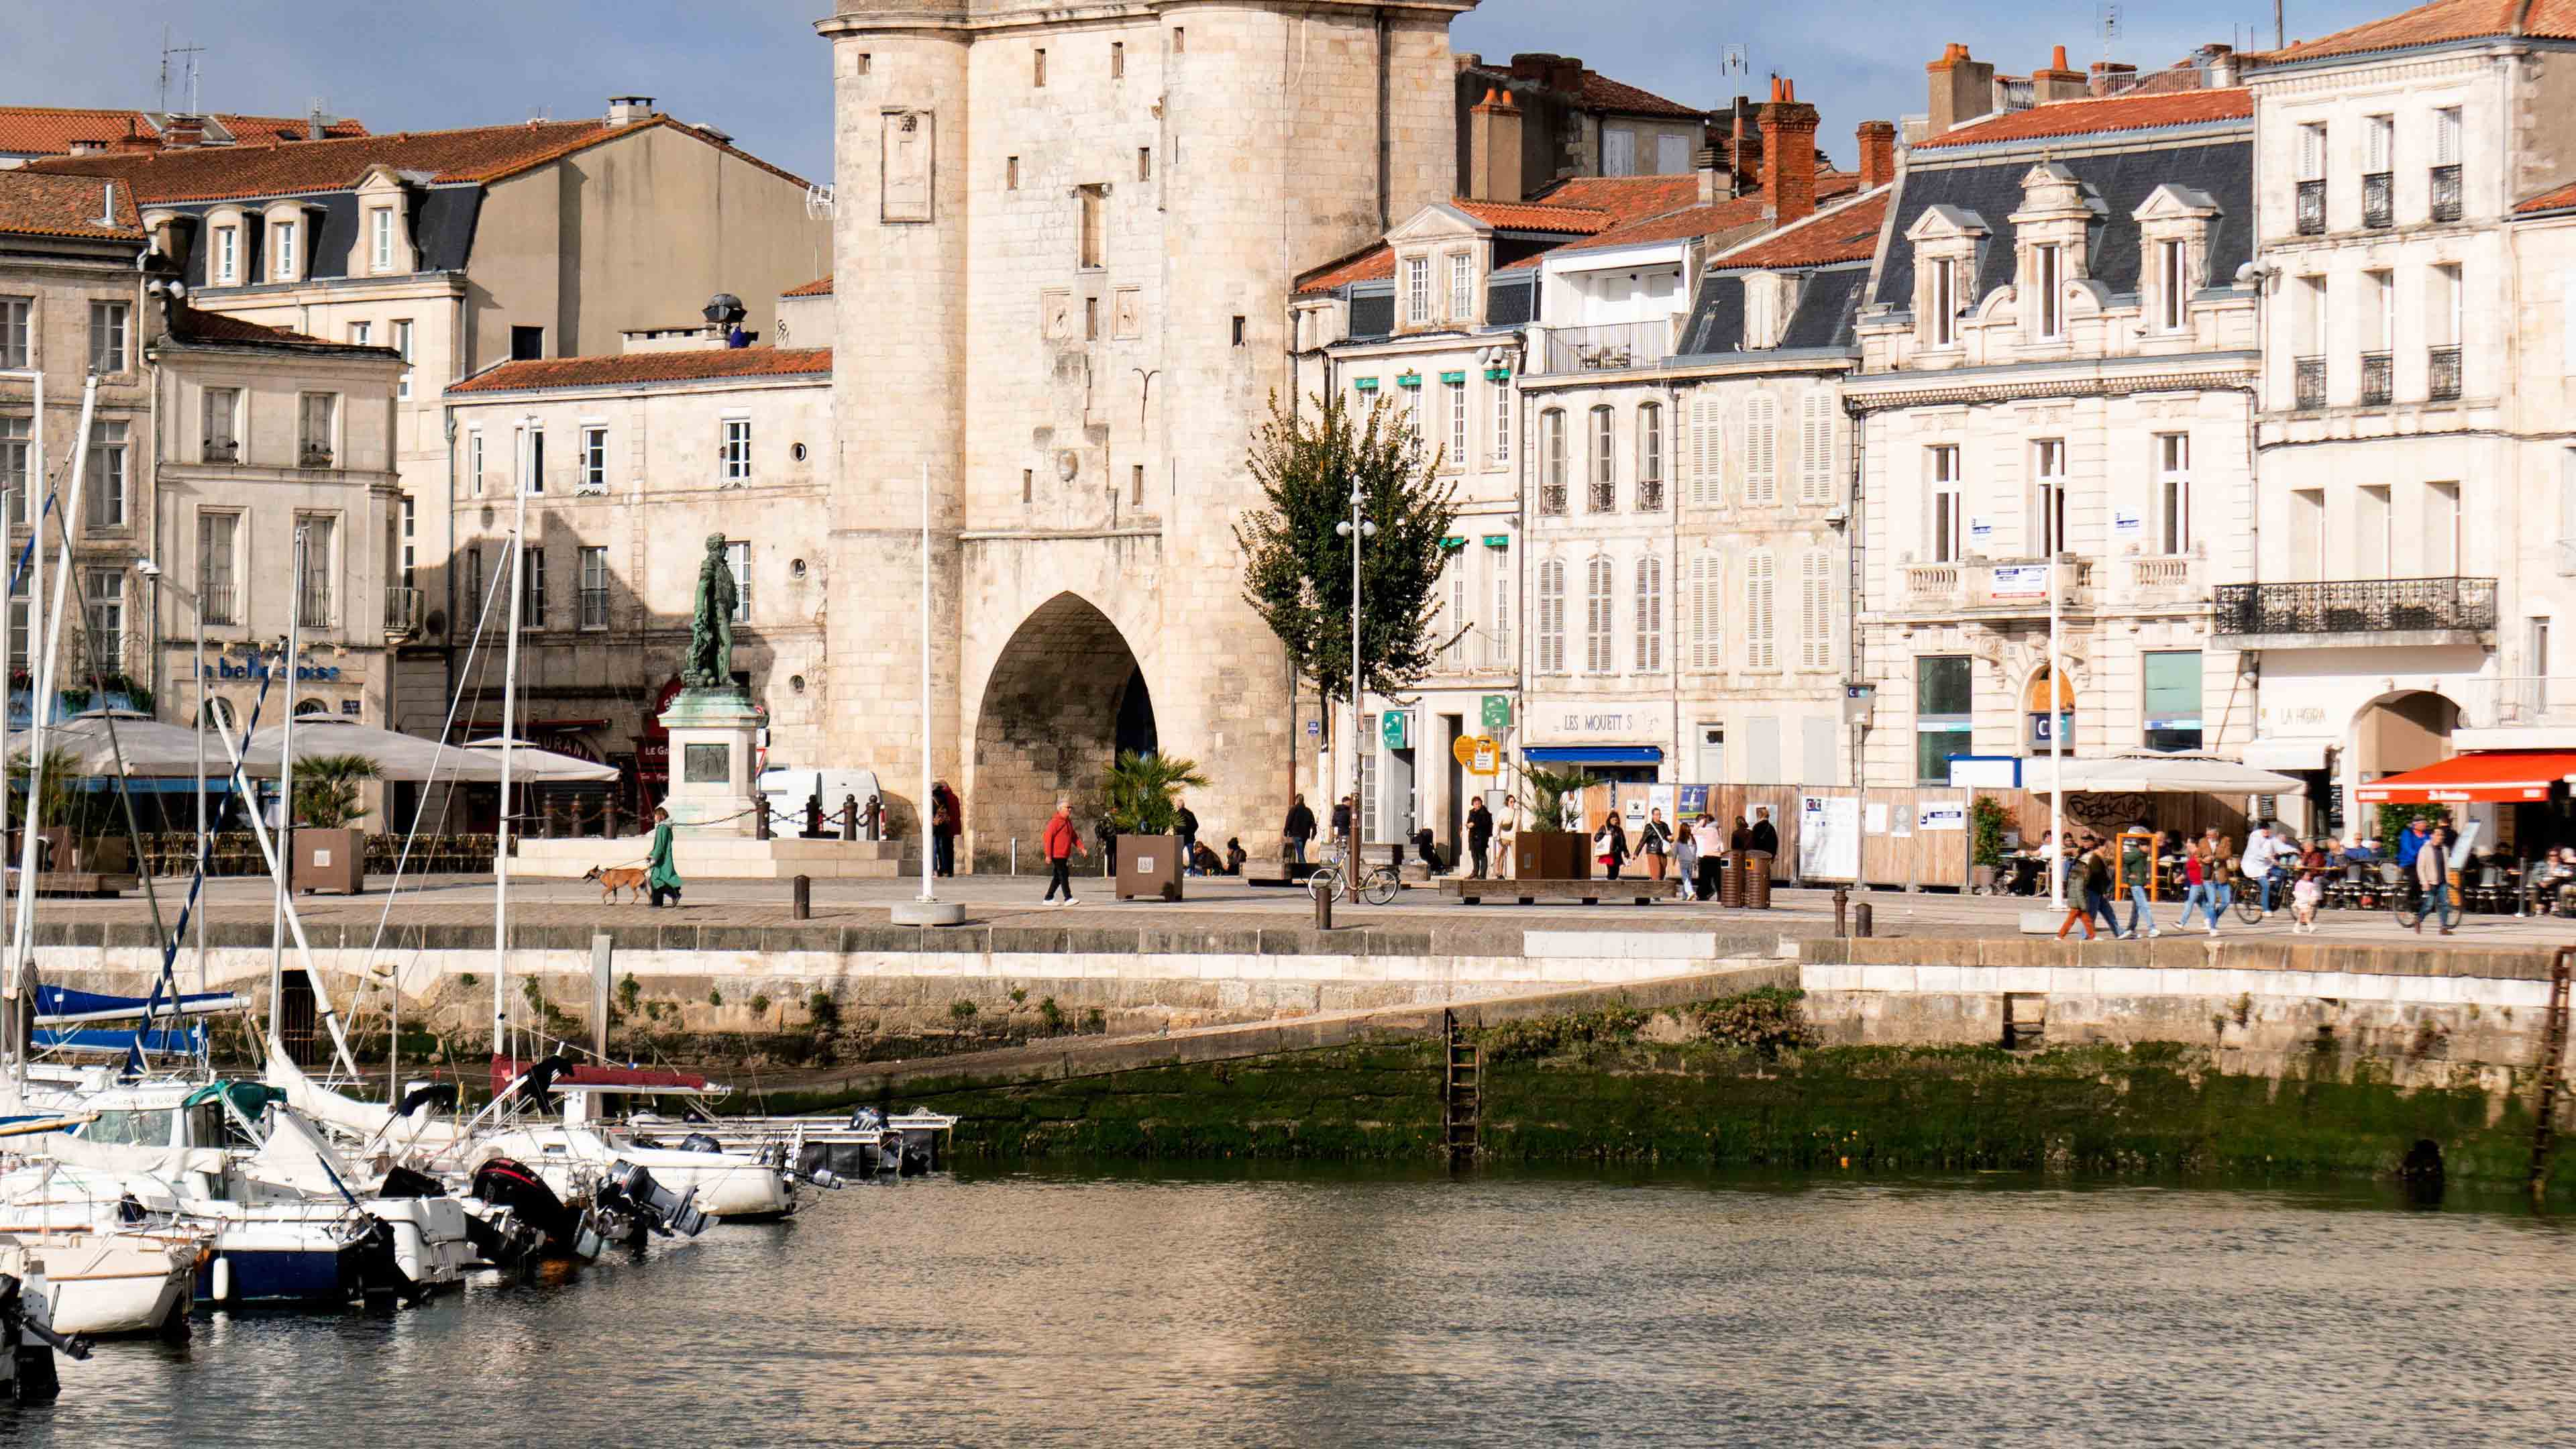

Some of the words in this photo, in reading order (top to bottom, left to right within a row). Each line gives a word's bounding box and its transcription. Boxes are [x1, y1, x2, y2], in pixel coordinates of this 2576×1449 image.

[1564, 714, 1578, 731] LES
[2038, 719, 2066, 737] CC
[645, 747, 656, 756] LE
